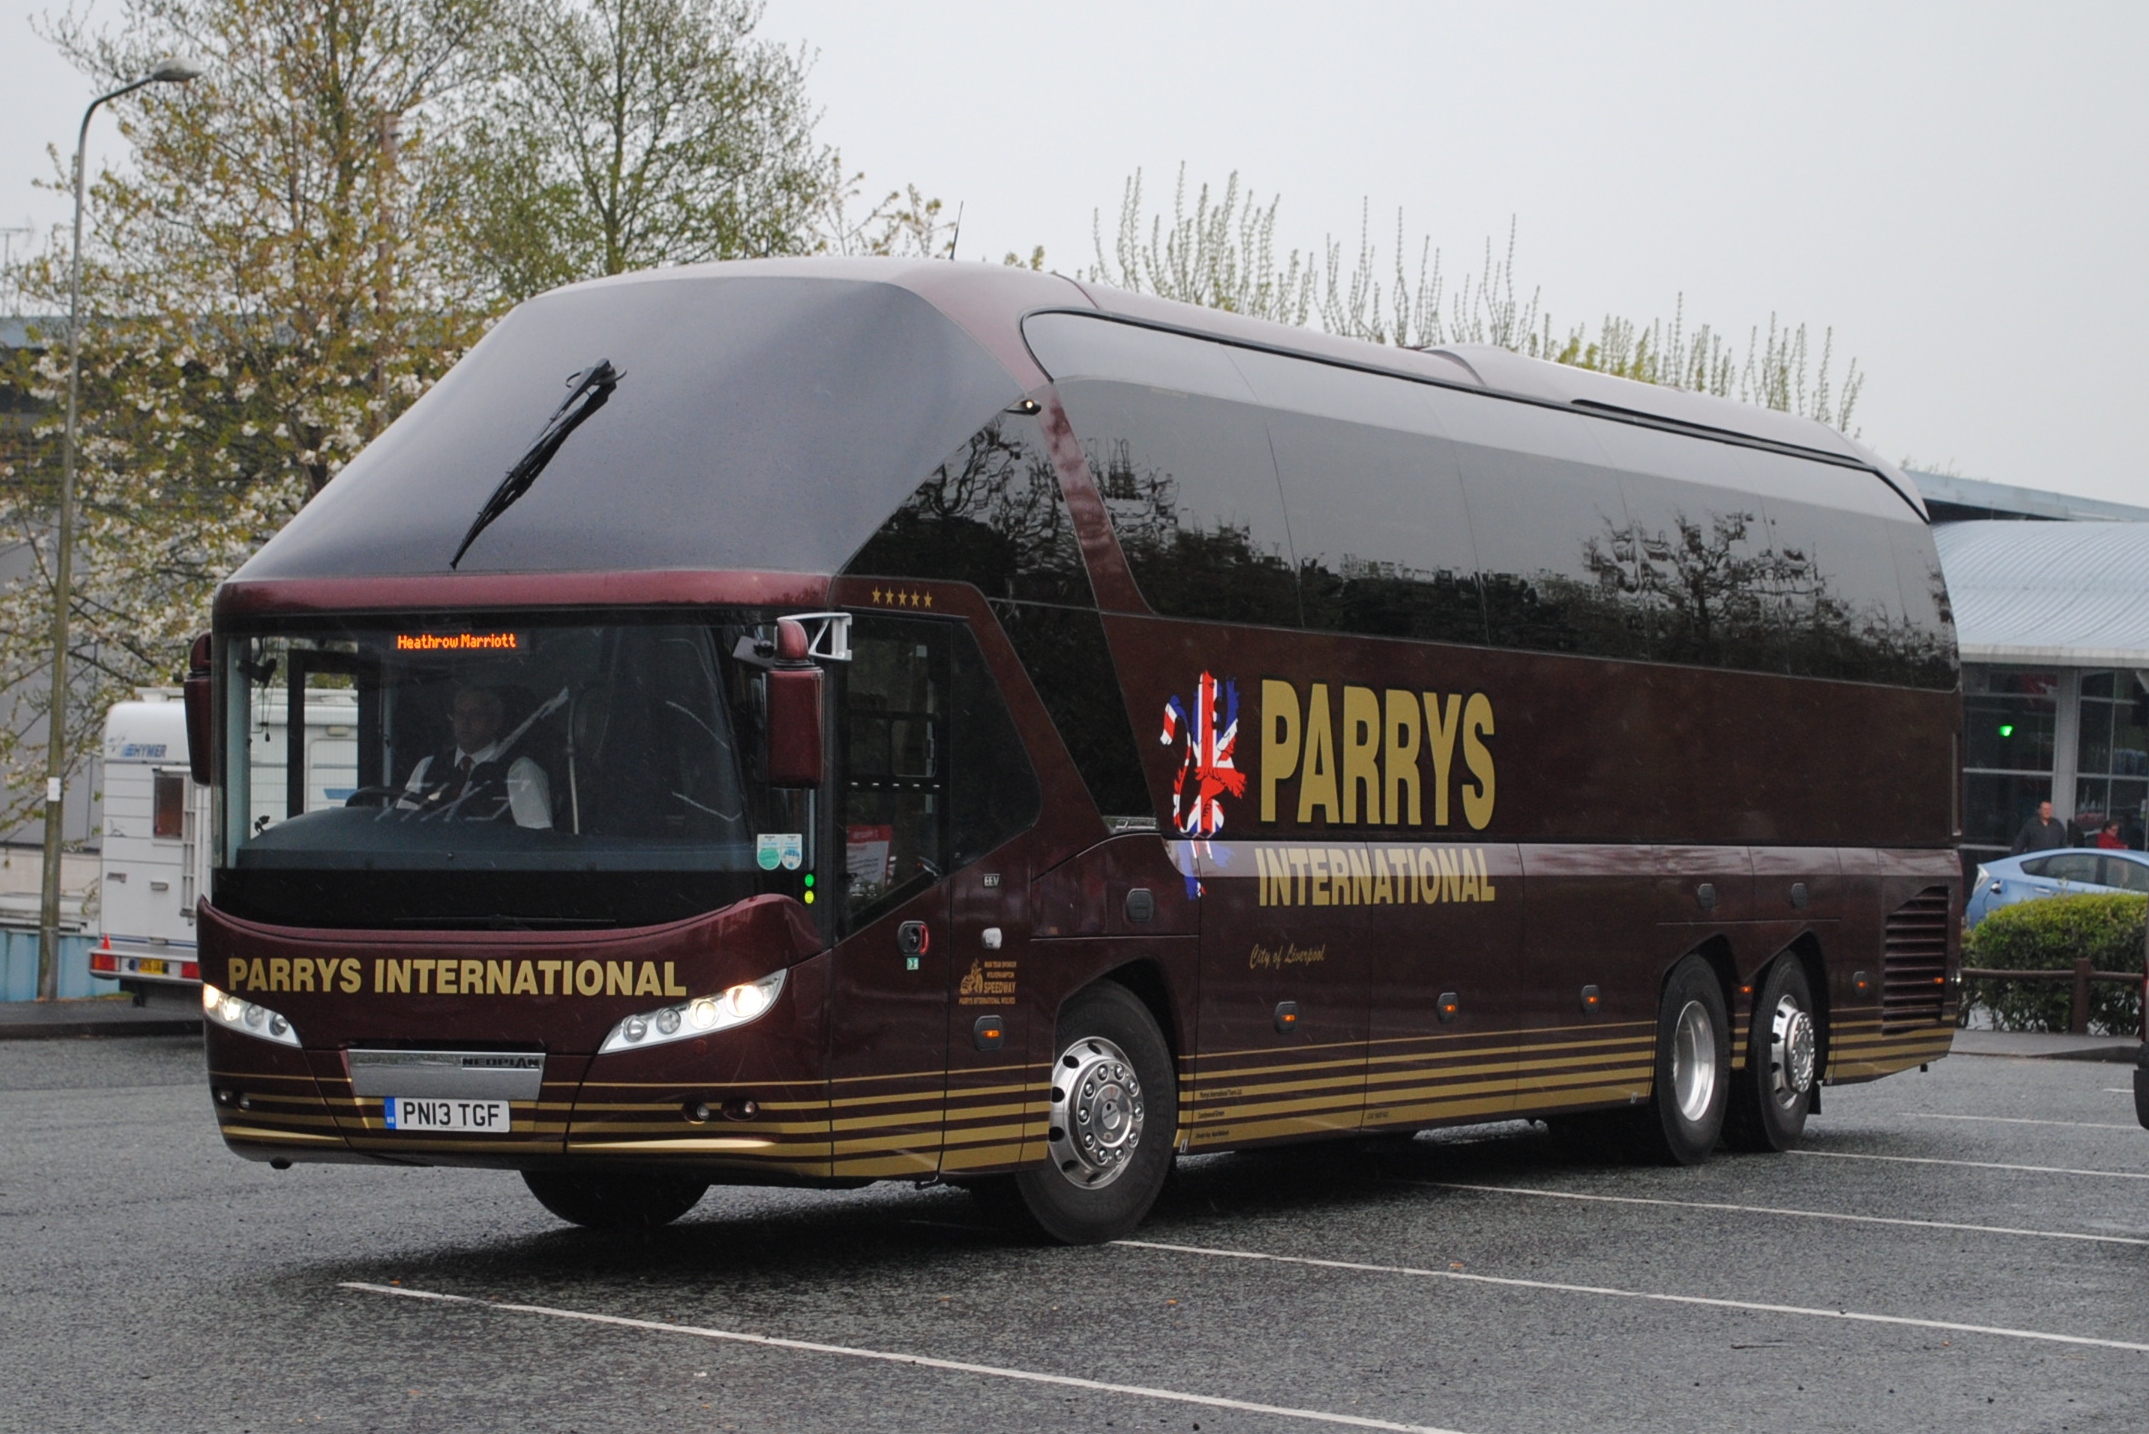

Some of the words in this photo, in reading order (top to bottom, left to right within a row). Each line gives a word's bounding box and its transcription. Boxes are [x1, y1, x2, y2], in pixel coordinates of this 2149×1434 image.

[397, 634, 459, 649] Heathrow
[460, 633, 516, 648] Marriott
[1260, 679, 1496, 831] PARRYS
[983, 875, 1000, 887] EEV
[1254, 847, 1496, 907] INTERNATIONAL
[1249, 943, 1271, 969] City
[1272, 945, 1283, 970] of
[228, 957, 362, 993] PARRYS
[374, 959, 687, 997] INTERNATIONAL
[984, 981, 1016, 994] SPEEDWAY
[462, 1057, 540, 1068] NEOPLAN
[403, 1102, 451, 1126] PN13
[458, 1104, 501, 1127] TGF
